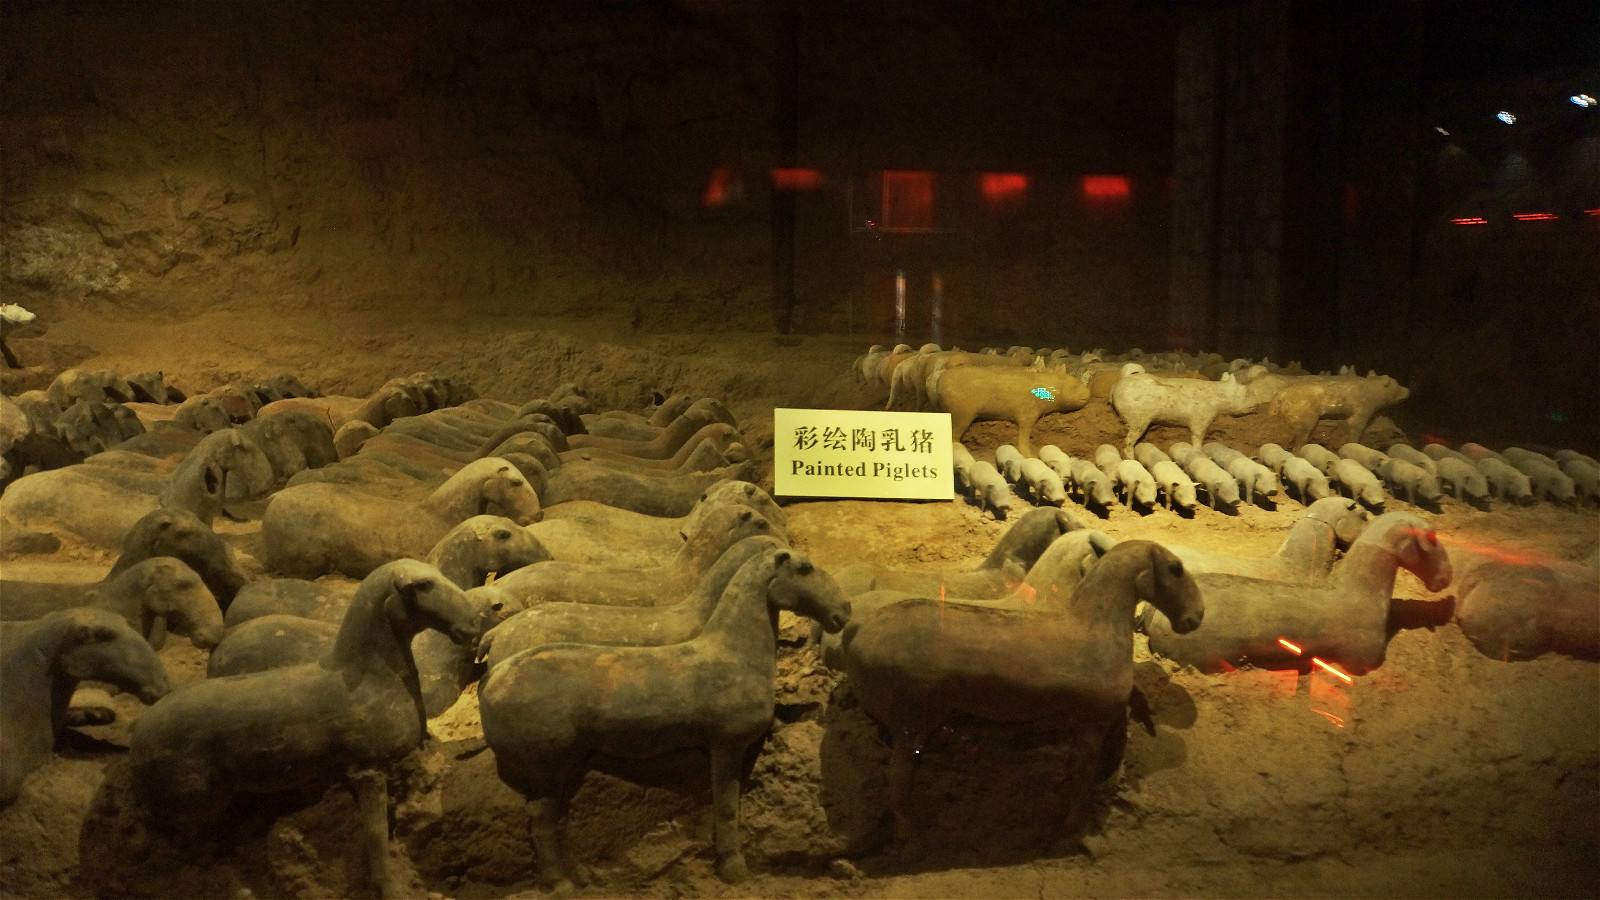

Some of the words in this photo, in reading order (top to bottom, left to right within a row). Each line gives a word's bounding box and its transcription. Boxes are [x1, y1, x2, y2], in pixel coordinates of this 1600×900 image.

[793, 425, 935, 454] 彩绘陶乳猪
[792, 460, 866, 477] Painted
[873, 462, 938, 481] Piglets
